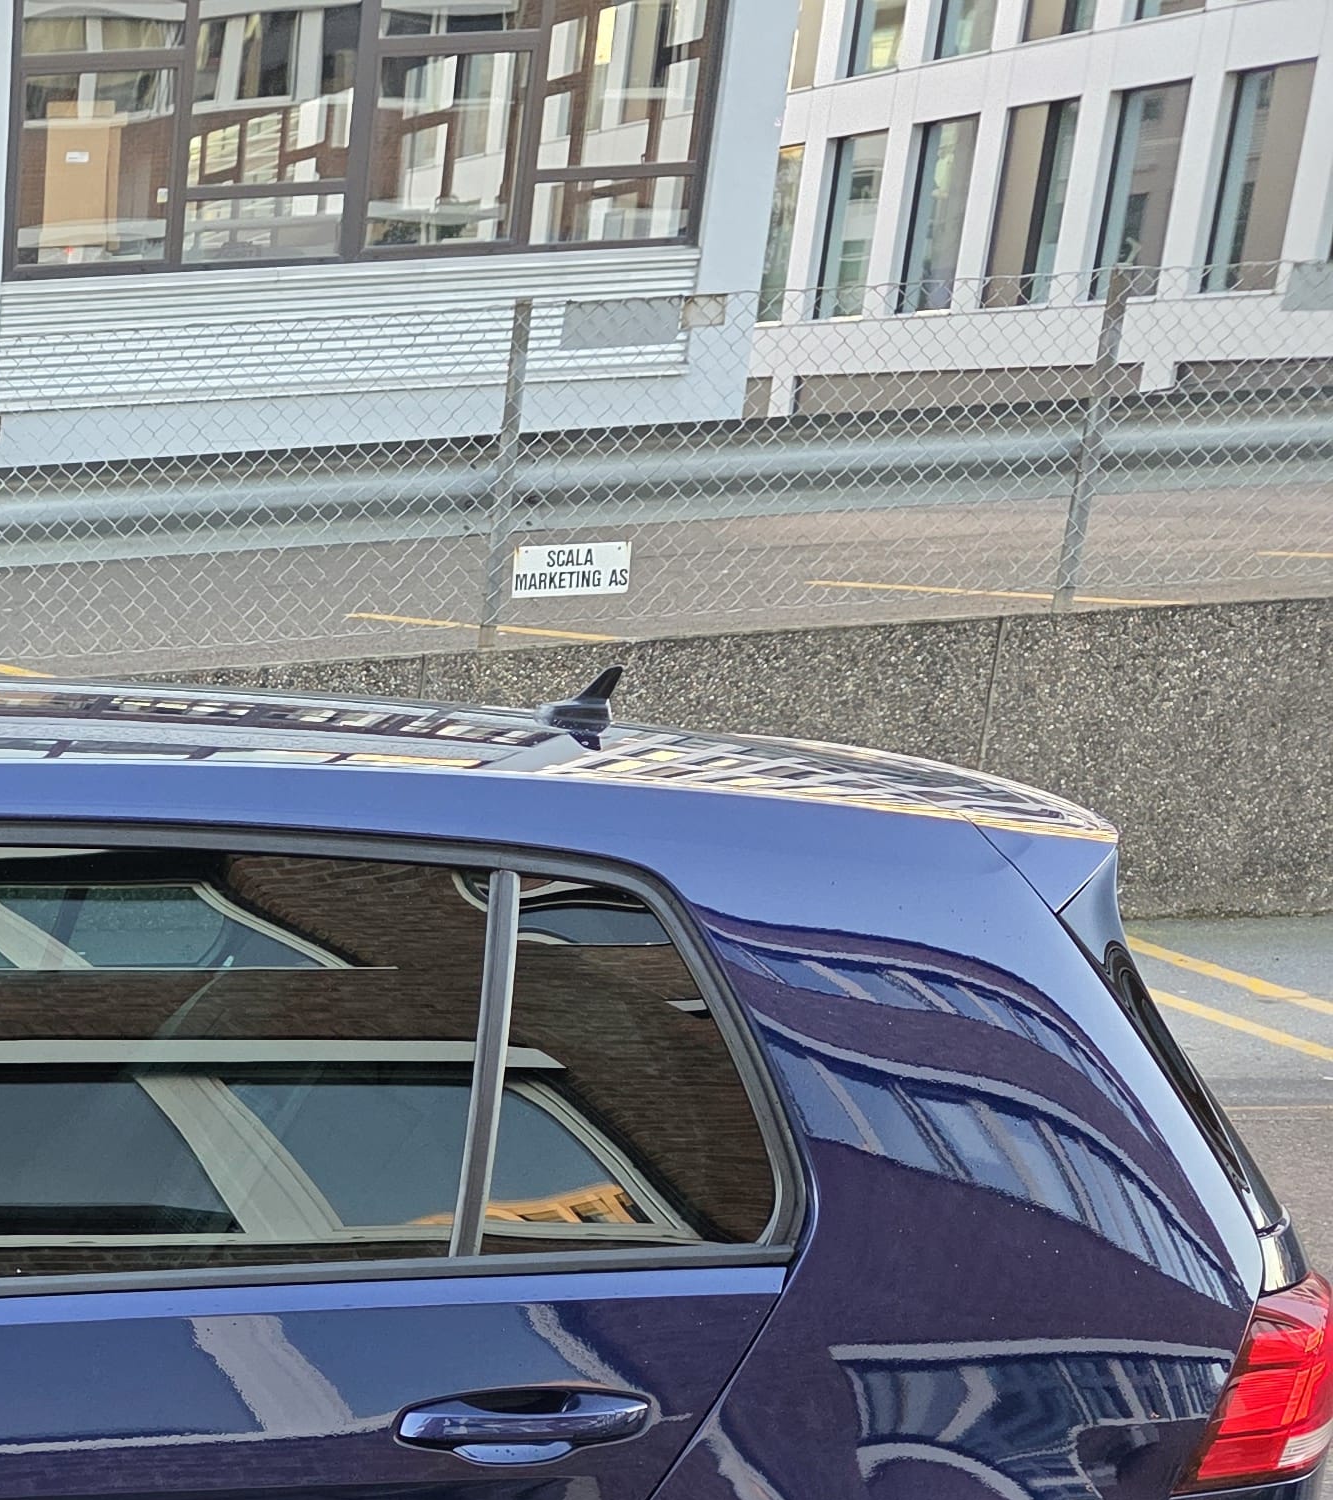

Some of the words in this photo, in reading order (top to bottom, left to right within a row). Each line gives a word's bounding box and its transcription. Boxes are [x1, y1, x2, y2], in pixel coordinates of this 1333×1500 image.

[546, 548, 594, 568] SCALA
[514, 569, 602, 592] MARKETING
[608, 568, 629, 587] AS
